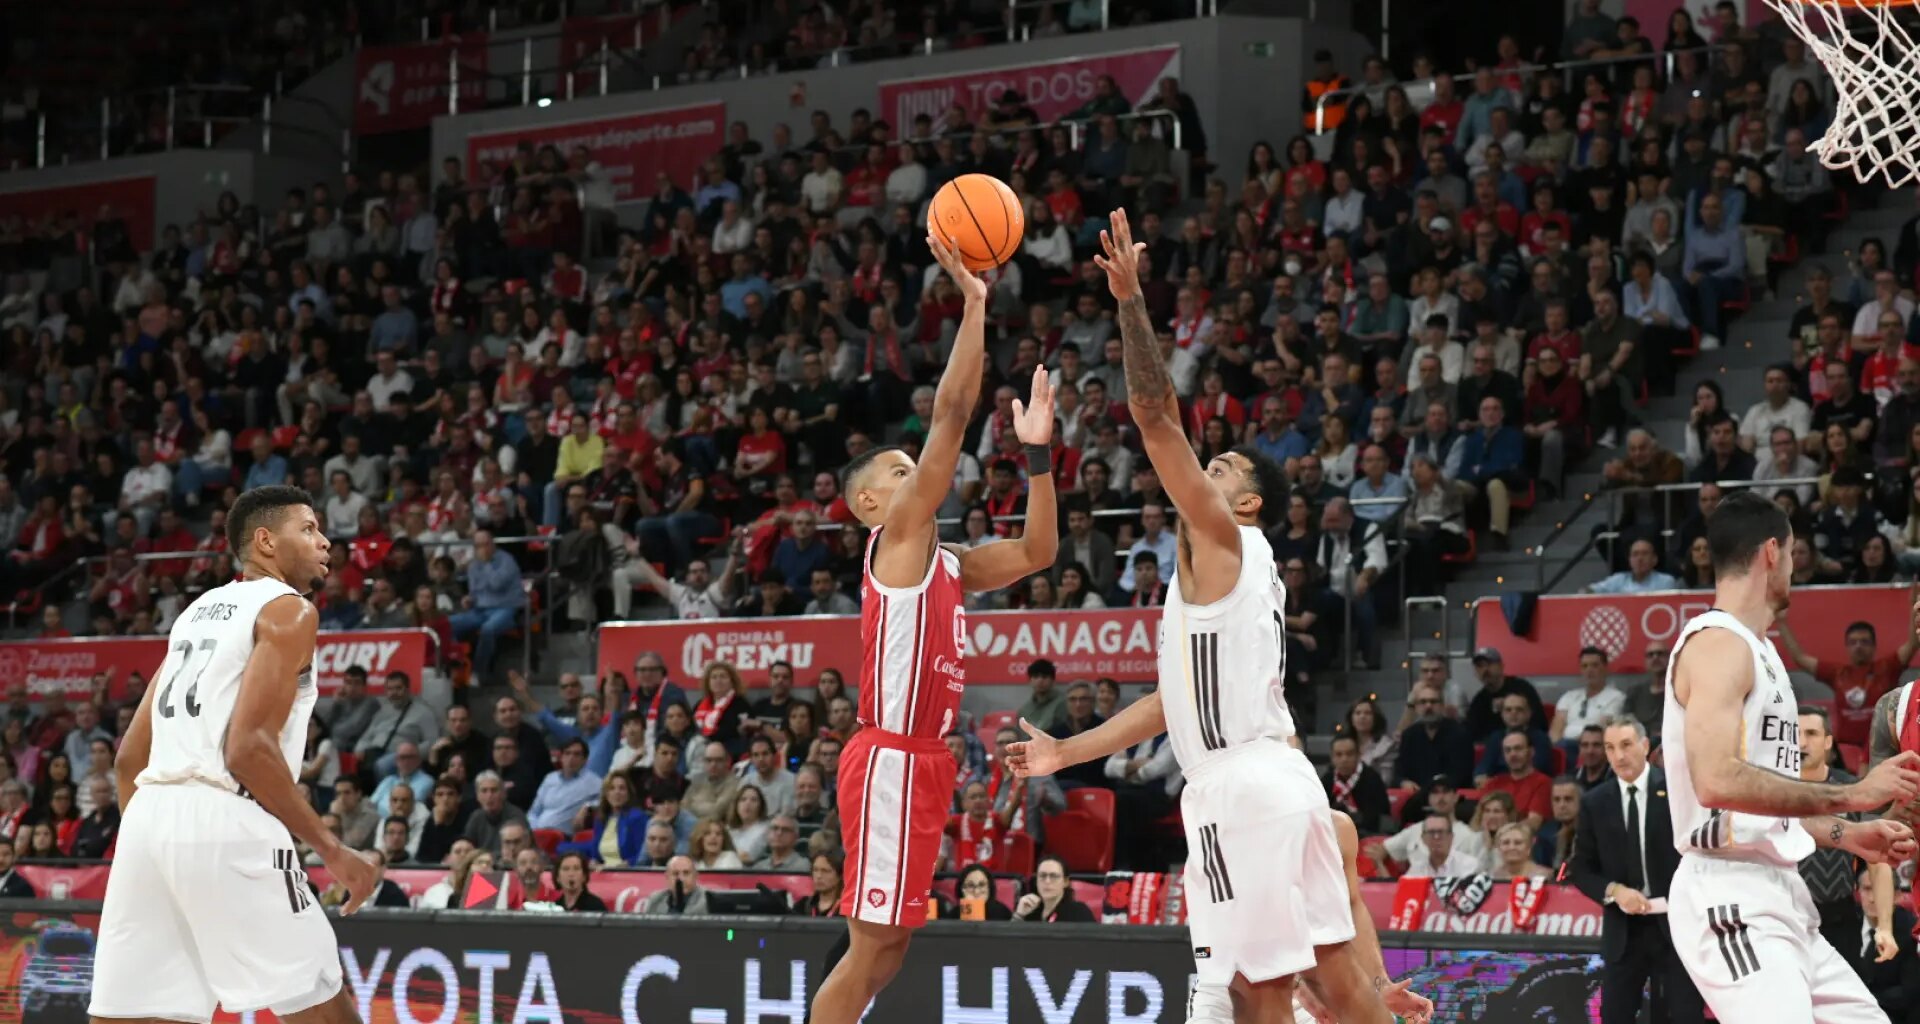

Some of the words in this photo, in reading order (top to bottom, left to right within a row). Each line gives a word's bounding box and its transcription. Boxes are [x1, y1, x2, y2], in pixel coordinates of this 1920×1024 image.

[967, 69, 1094, 110] TODOS
[715, 642, 814, 670] CEMU
[716, 631, 784, 644] BOMBAS
[1009, 619, 1165, 656] ANAGA
[158, 639, 217, 718] 22
[240, 947, 563, 1024] YOTA
[620, 954, 876, 1024] C-H
